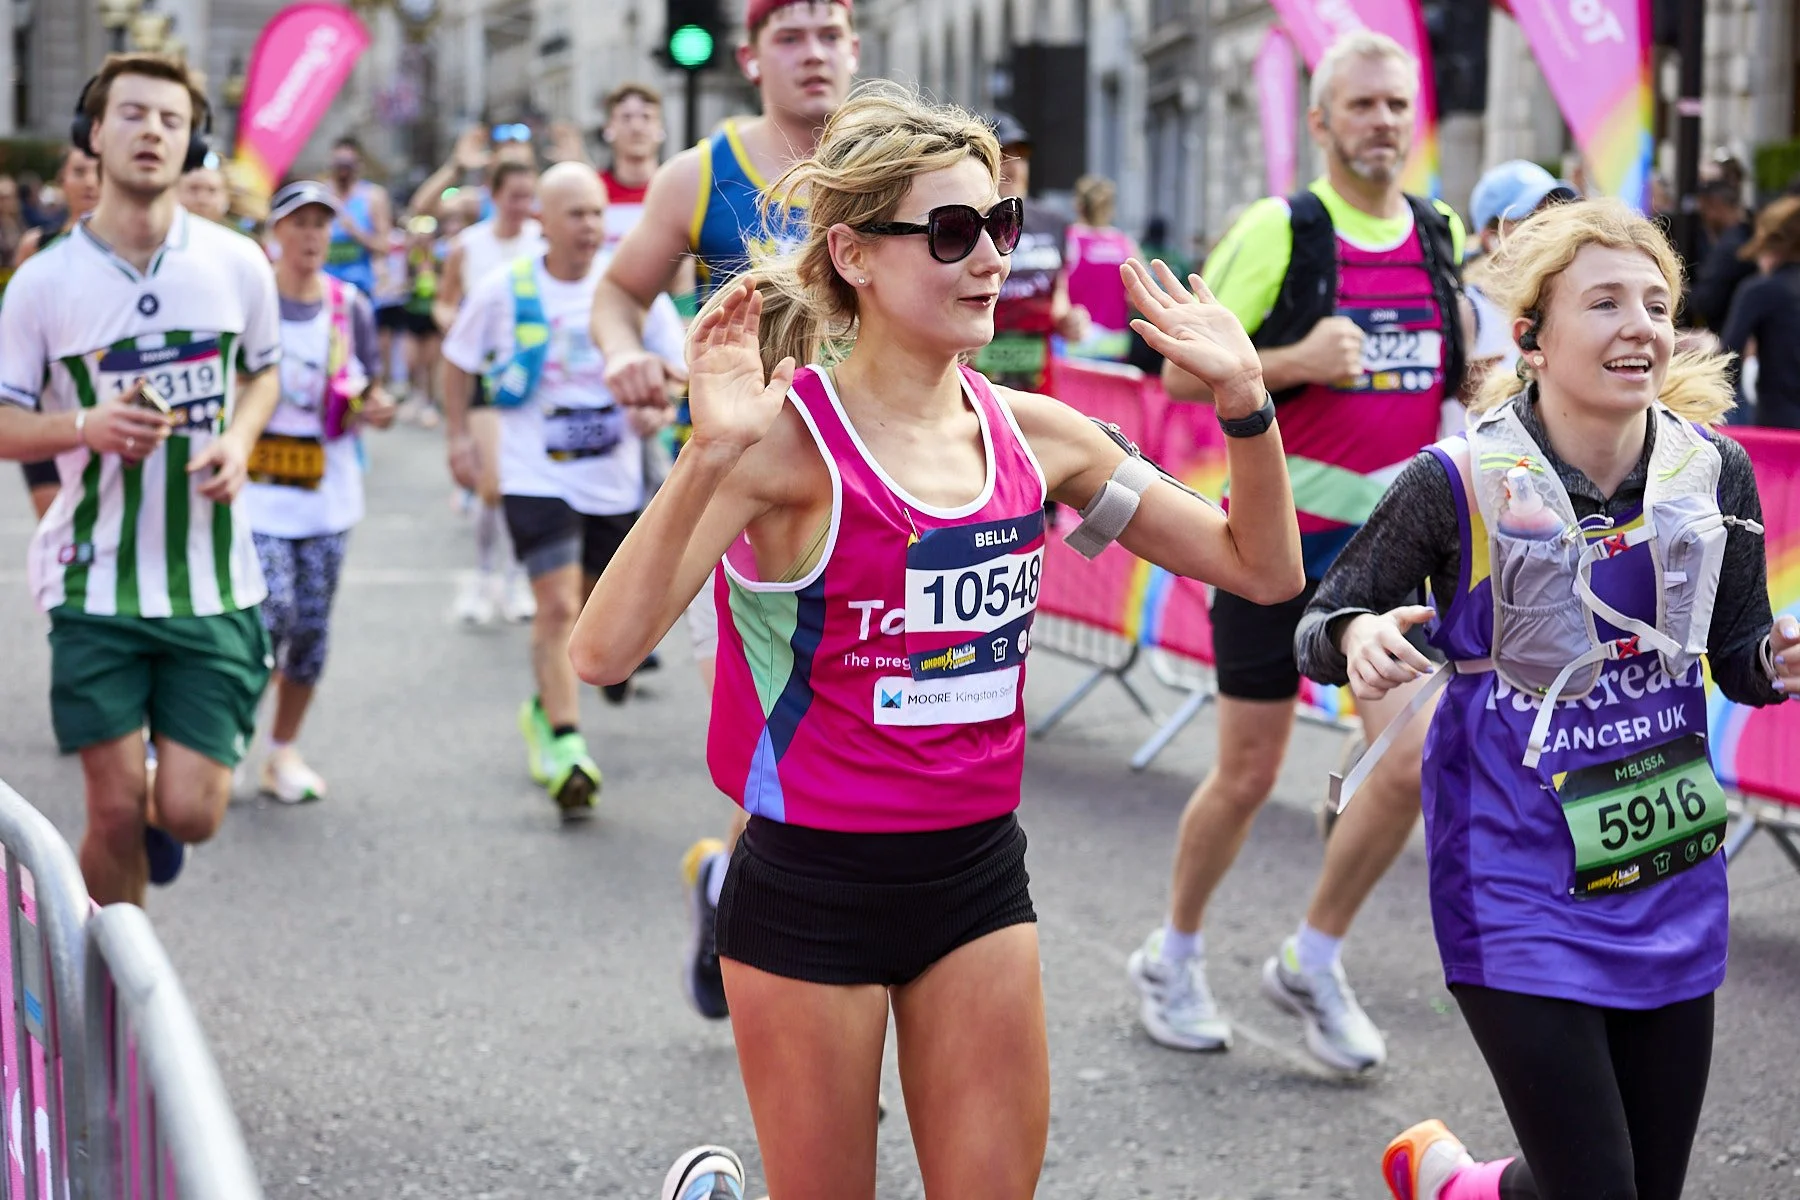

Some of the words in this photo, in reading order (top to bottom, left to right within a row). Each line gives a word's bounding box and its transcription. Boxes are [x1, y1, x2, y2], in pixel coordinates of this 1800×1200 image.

[112, 366, 214, 400] 1319
[974, 527, 1018, 548] BELLA
[923, 554, 1040, 625] 10548
[921, 655, 946, 671] LONDON
[907, 692, 951, 705] MOORE
[956, 688, 998, 703] Kingston
[1657, 704, 1687, 733] UK
[1615, 753, 1665, 782] MELISSA
[1598, 778, 1707, 851] 5916
